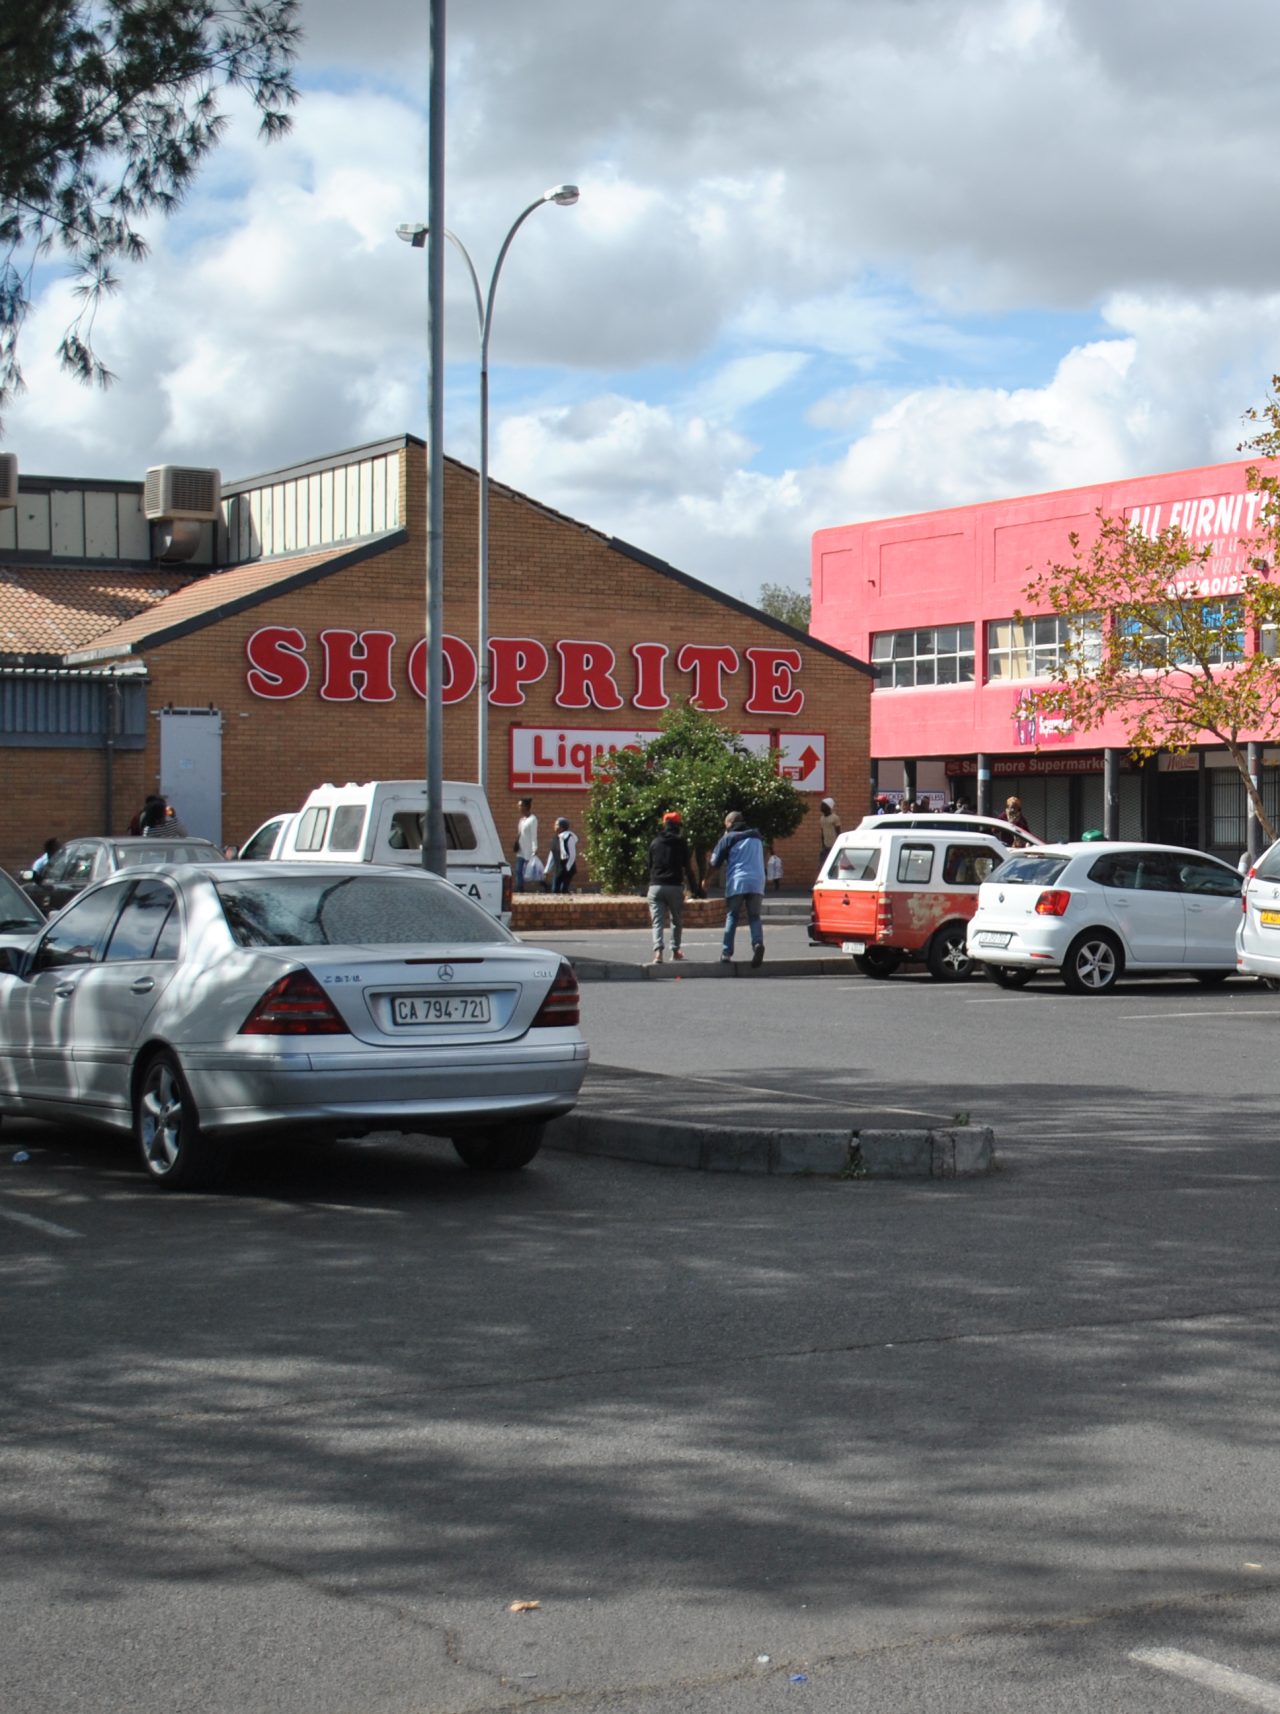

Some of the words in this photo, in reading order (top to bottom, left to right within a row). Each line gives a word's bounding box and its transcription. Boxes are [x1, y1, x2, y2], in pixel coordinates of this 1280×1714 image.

[1127, 505, 1162, 543] ALL
[247, 626, 804, 715] SHOPRITE
[994, 760, 1025, 772] more
[1028, 756, 1107, 774] Supermarke
[398, 1000, 418, 1021] CA
[423, 998, 485, 1020] 794-721
